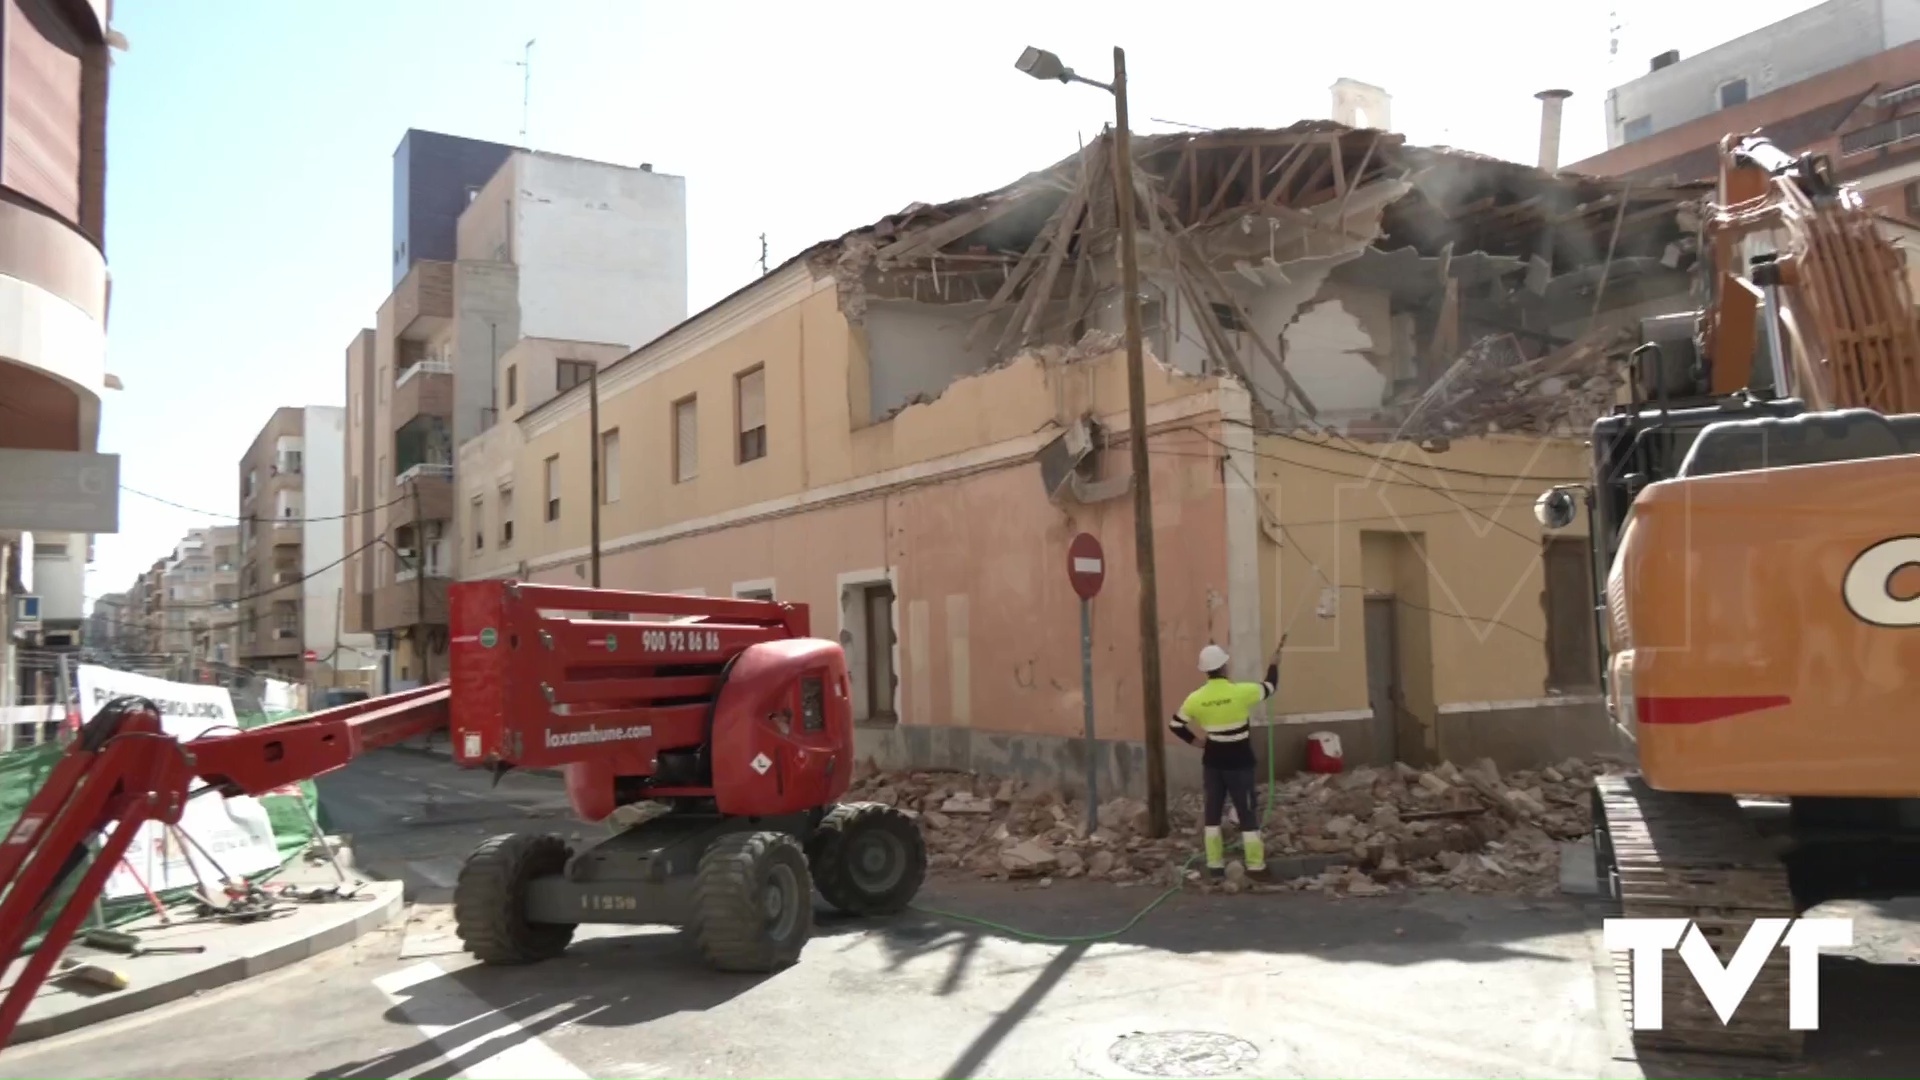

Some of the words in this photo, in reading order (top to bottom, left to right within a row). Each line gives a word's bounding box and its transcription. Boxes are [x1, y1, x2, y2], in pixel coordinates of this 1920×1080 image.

[642, 630, 666, 653] 900
[669, 630, 685, 653] 92
[688, 630, 702, 652] 86
[705, 630, 720, 652] 86
